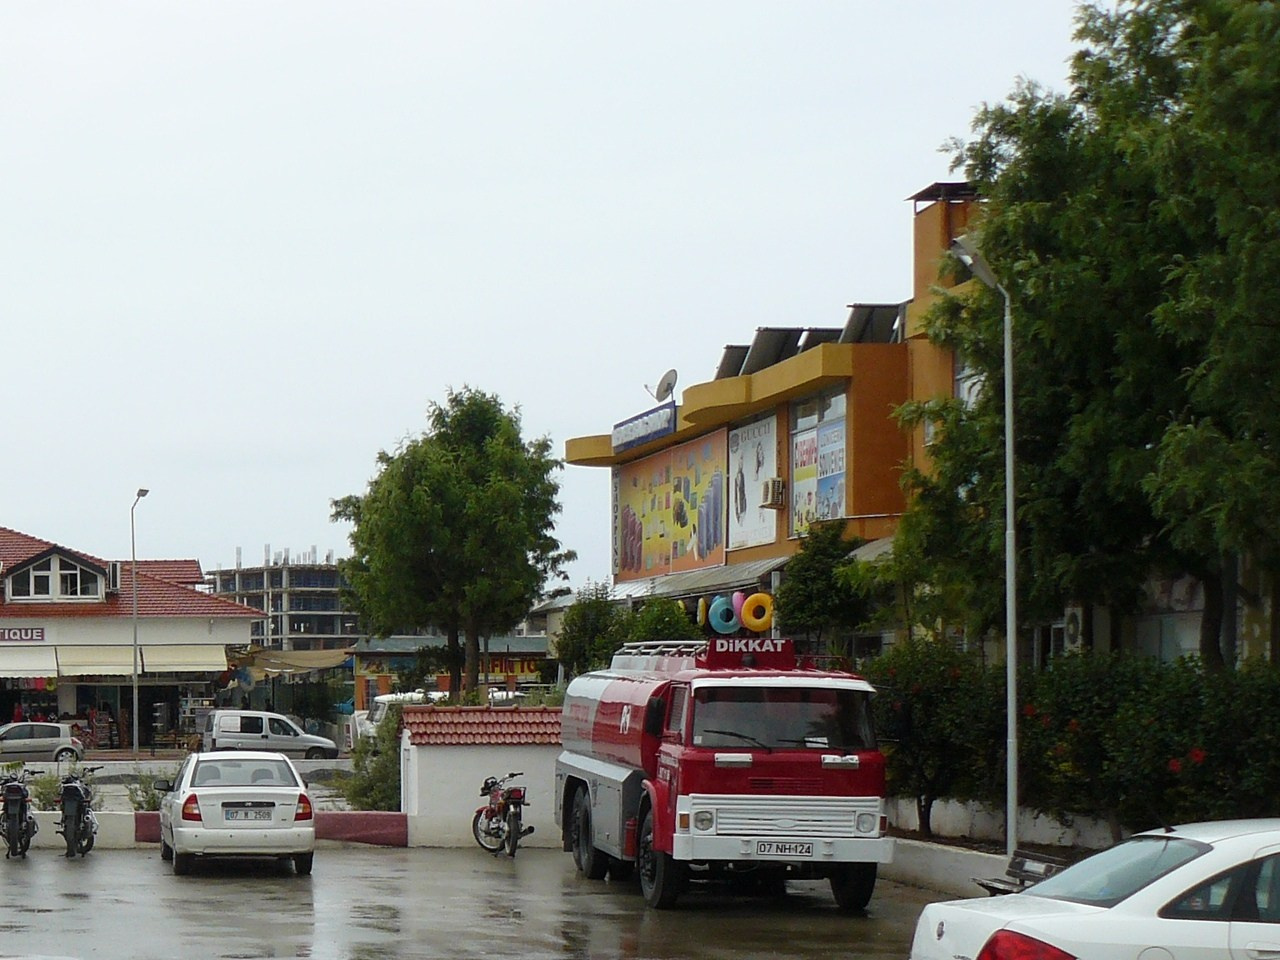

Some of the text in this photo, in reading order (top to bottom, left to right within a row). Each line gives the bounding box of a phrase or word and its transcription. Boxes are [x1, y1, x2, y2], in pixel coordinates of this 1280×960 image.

[759, 844, 811, 854] 07 NH 124
